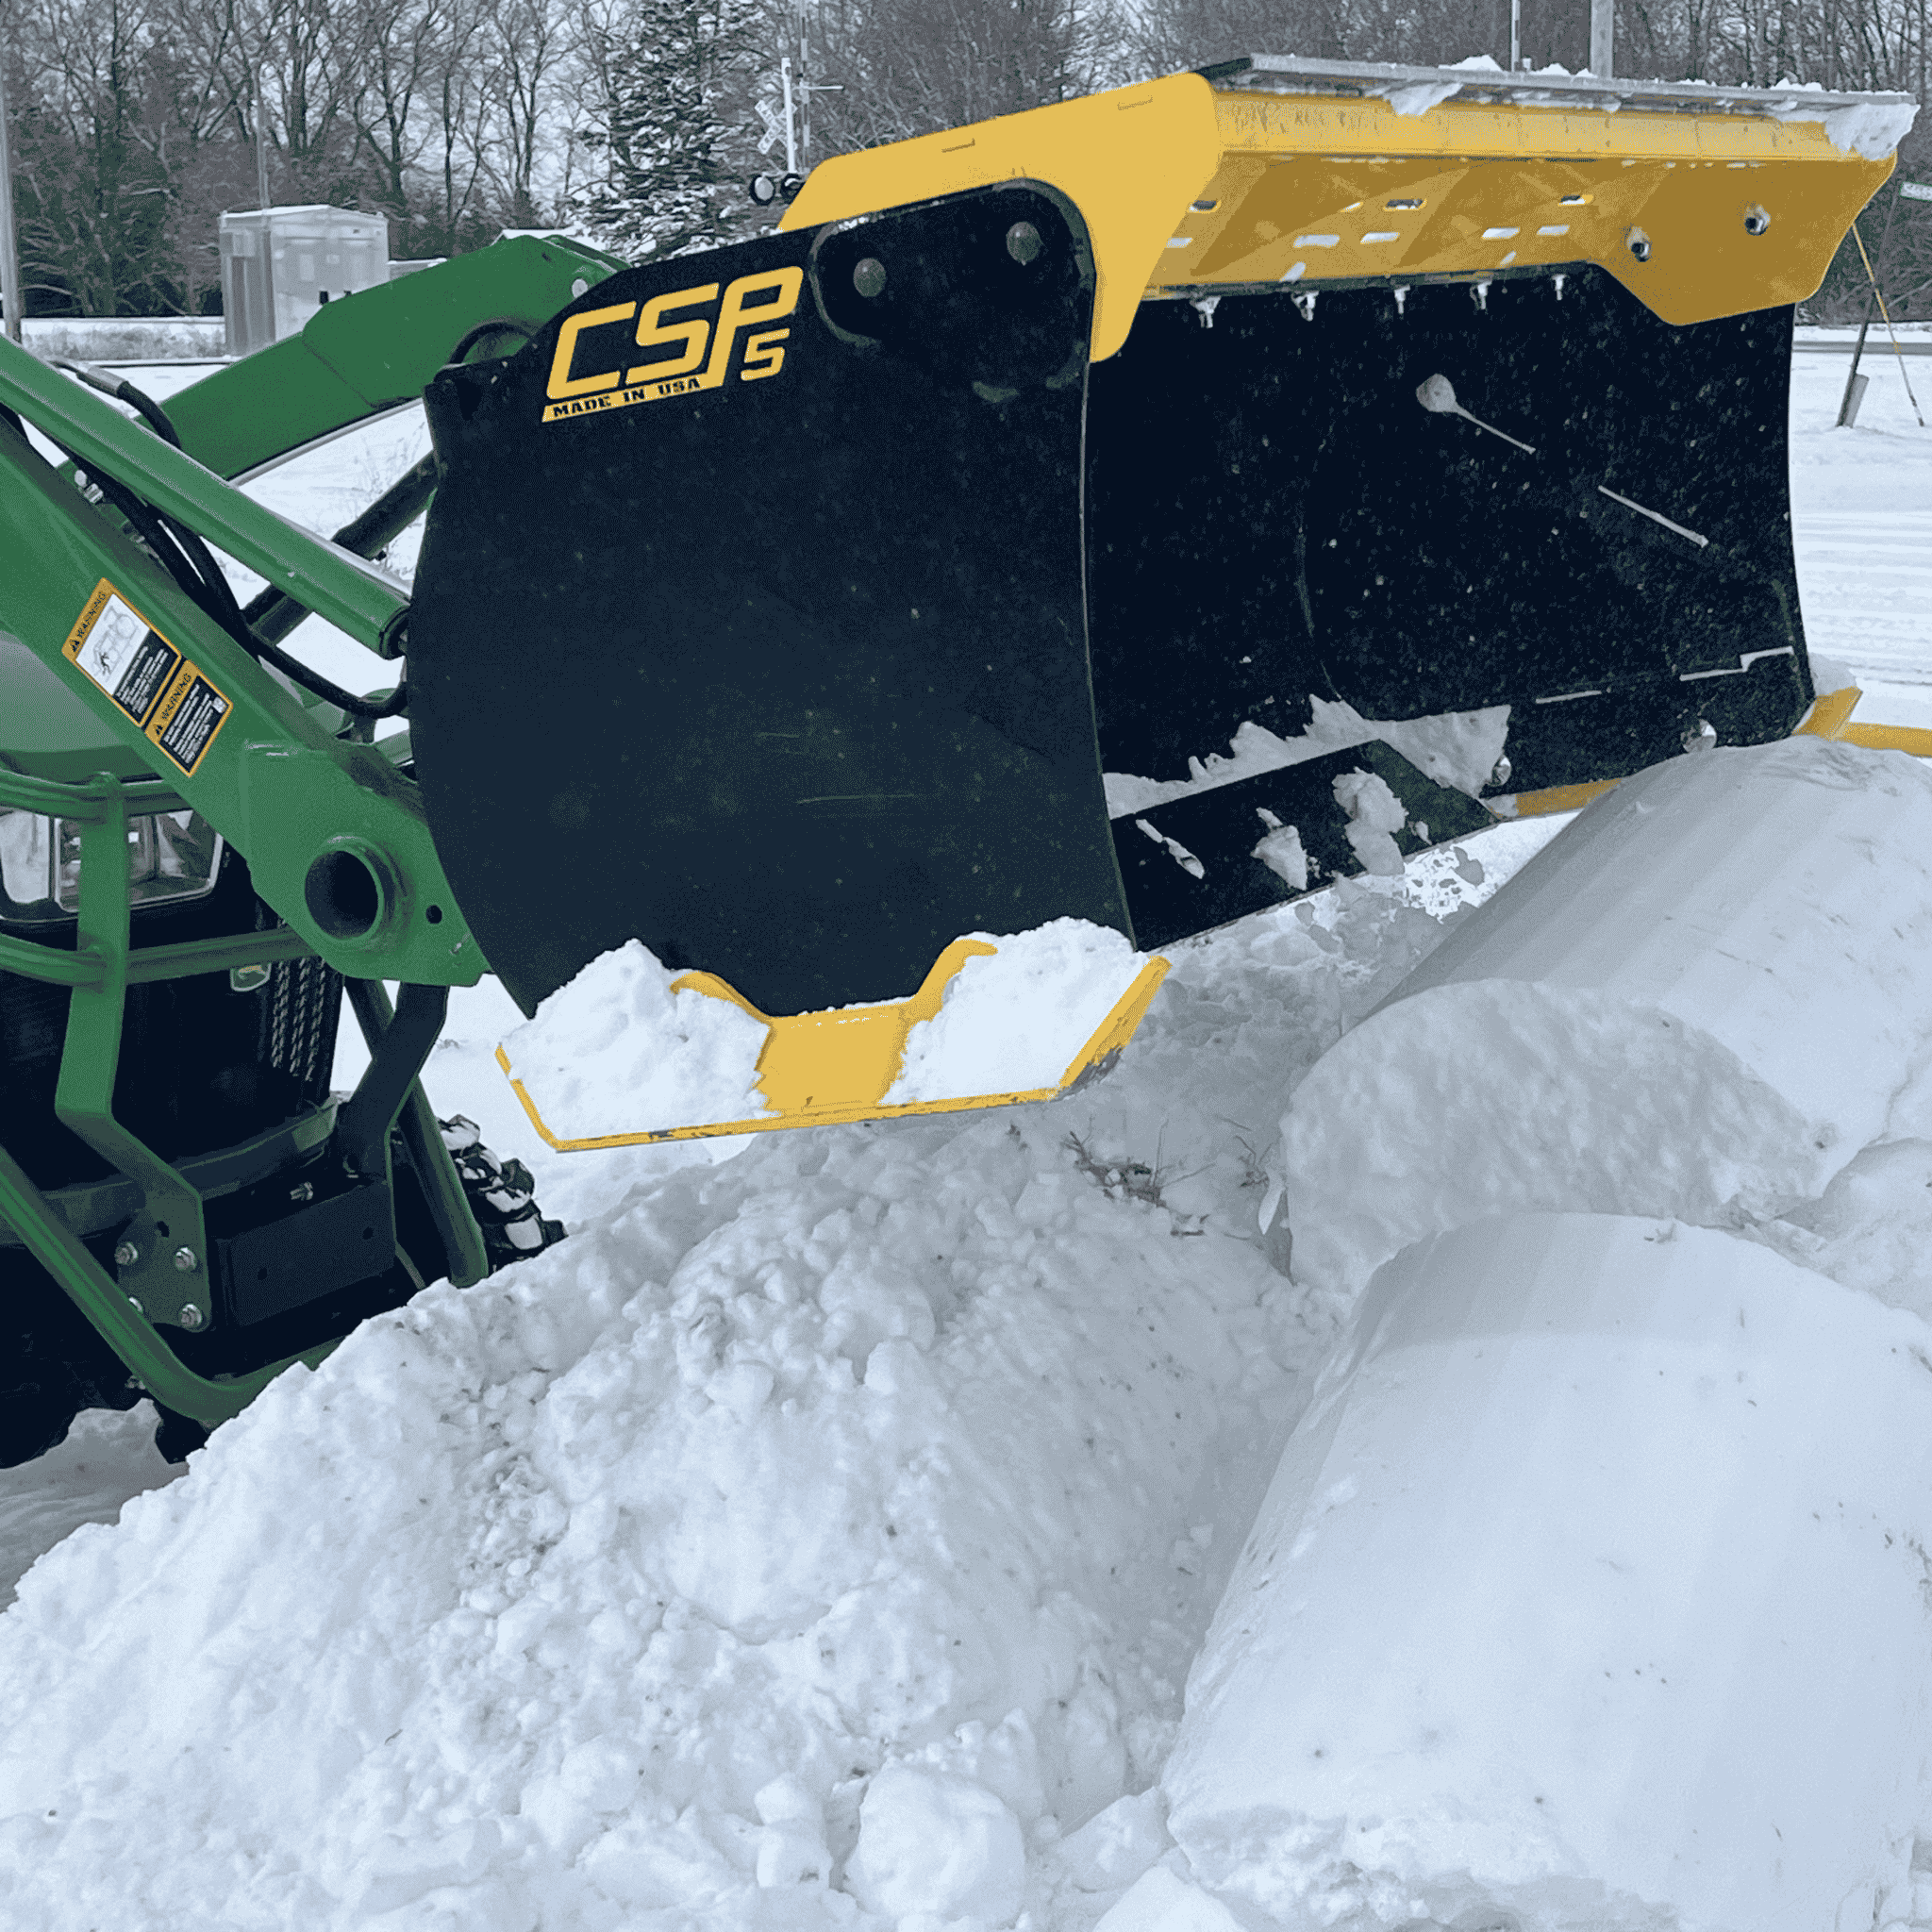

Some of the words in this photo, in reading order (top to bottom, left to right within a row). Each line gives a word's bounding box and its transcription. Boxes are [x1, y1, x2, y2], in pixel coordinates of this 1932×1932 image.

[546, 265, 803, 399] CSP
[552, 395, 611, 418] MADE
[623, 388, 645, 403] IN
[658, 377, 701, 395] USA
[76, 591, 107, 639] WARNING
[160, 673, 192, 720] WARNING
